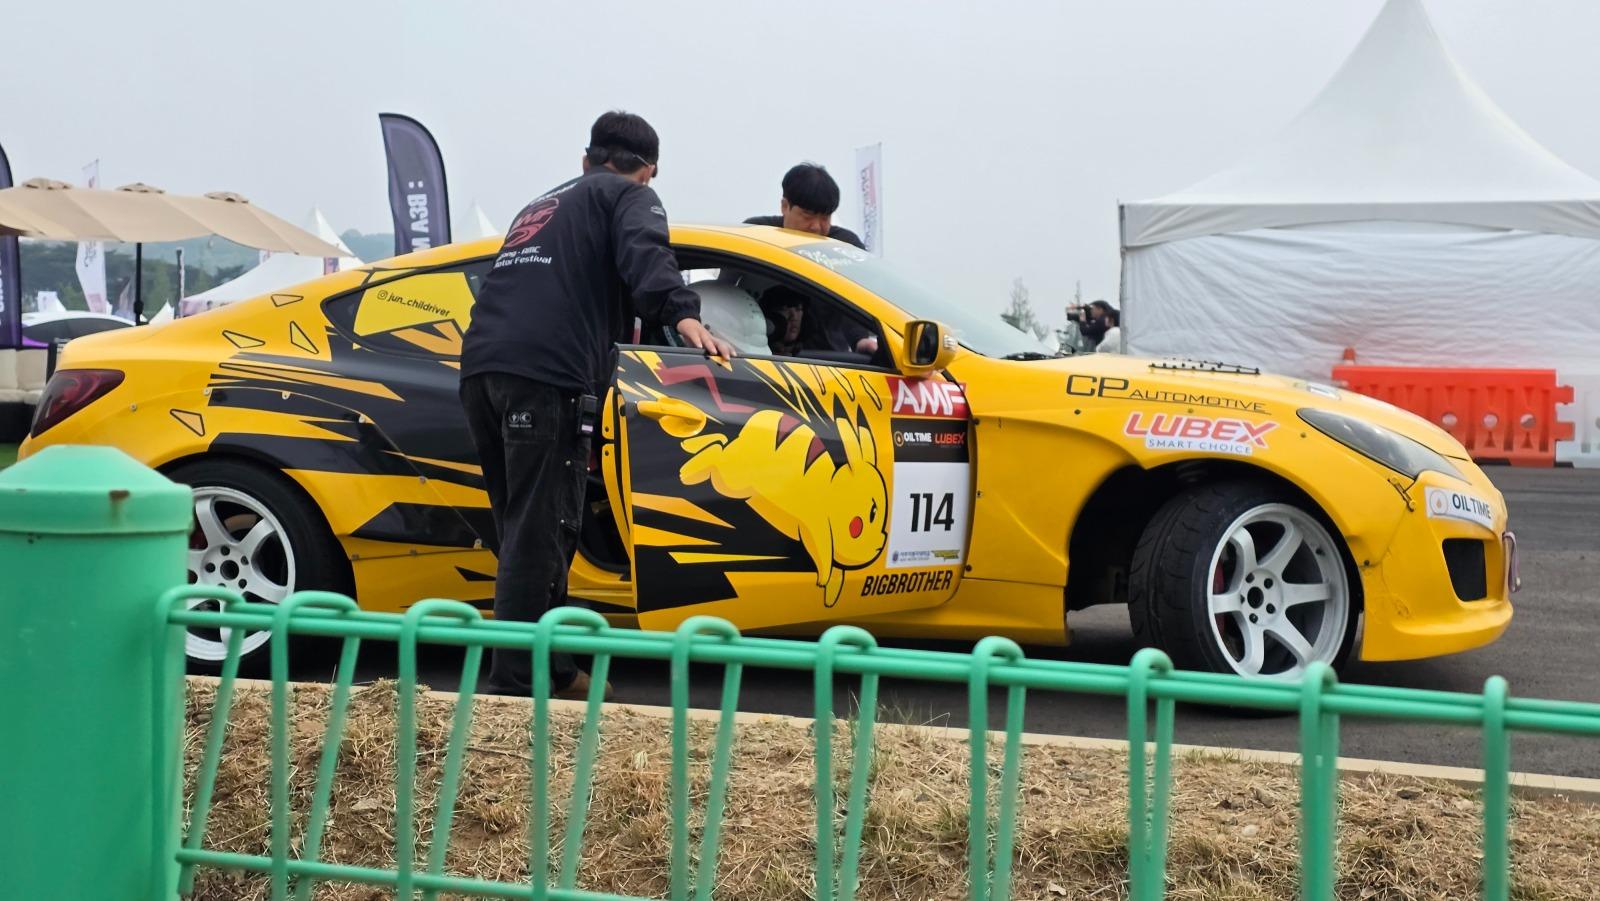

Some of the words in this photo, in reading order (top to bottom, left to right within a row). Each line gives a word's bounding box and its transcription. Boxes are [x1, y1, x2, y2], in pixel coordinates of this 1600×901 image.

[514, 255, 552, 265] Festival
[387, 292, 450, 317] jun_childriver
[893, 379, 965, 416] AMF
[1066, 374, 1129, 397] CP
[1129, 388, 1266, 412] AUTOMOTIVE
[903, 431, 916, 442] OIL
[914, 432, 932, 443] TIME
[934, 431, 965, 446] LUBEX
[1125, 413, 1277, 446] LUBEX
[1148, 438, 1193, 450] SMART
[1199, 441, 1251, 455] CHOICE
[909, 492, 954, 533] 114
[1452, 493, 1471, 513] OIL
[1470, 497, 1492, 519] TIME
[861, 569, 954, 597] BIGBROTHER
